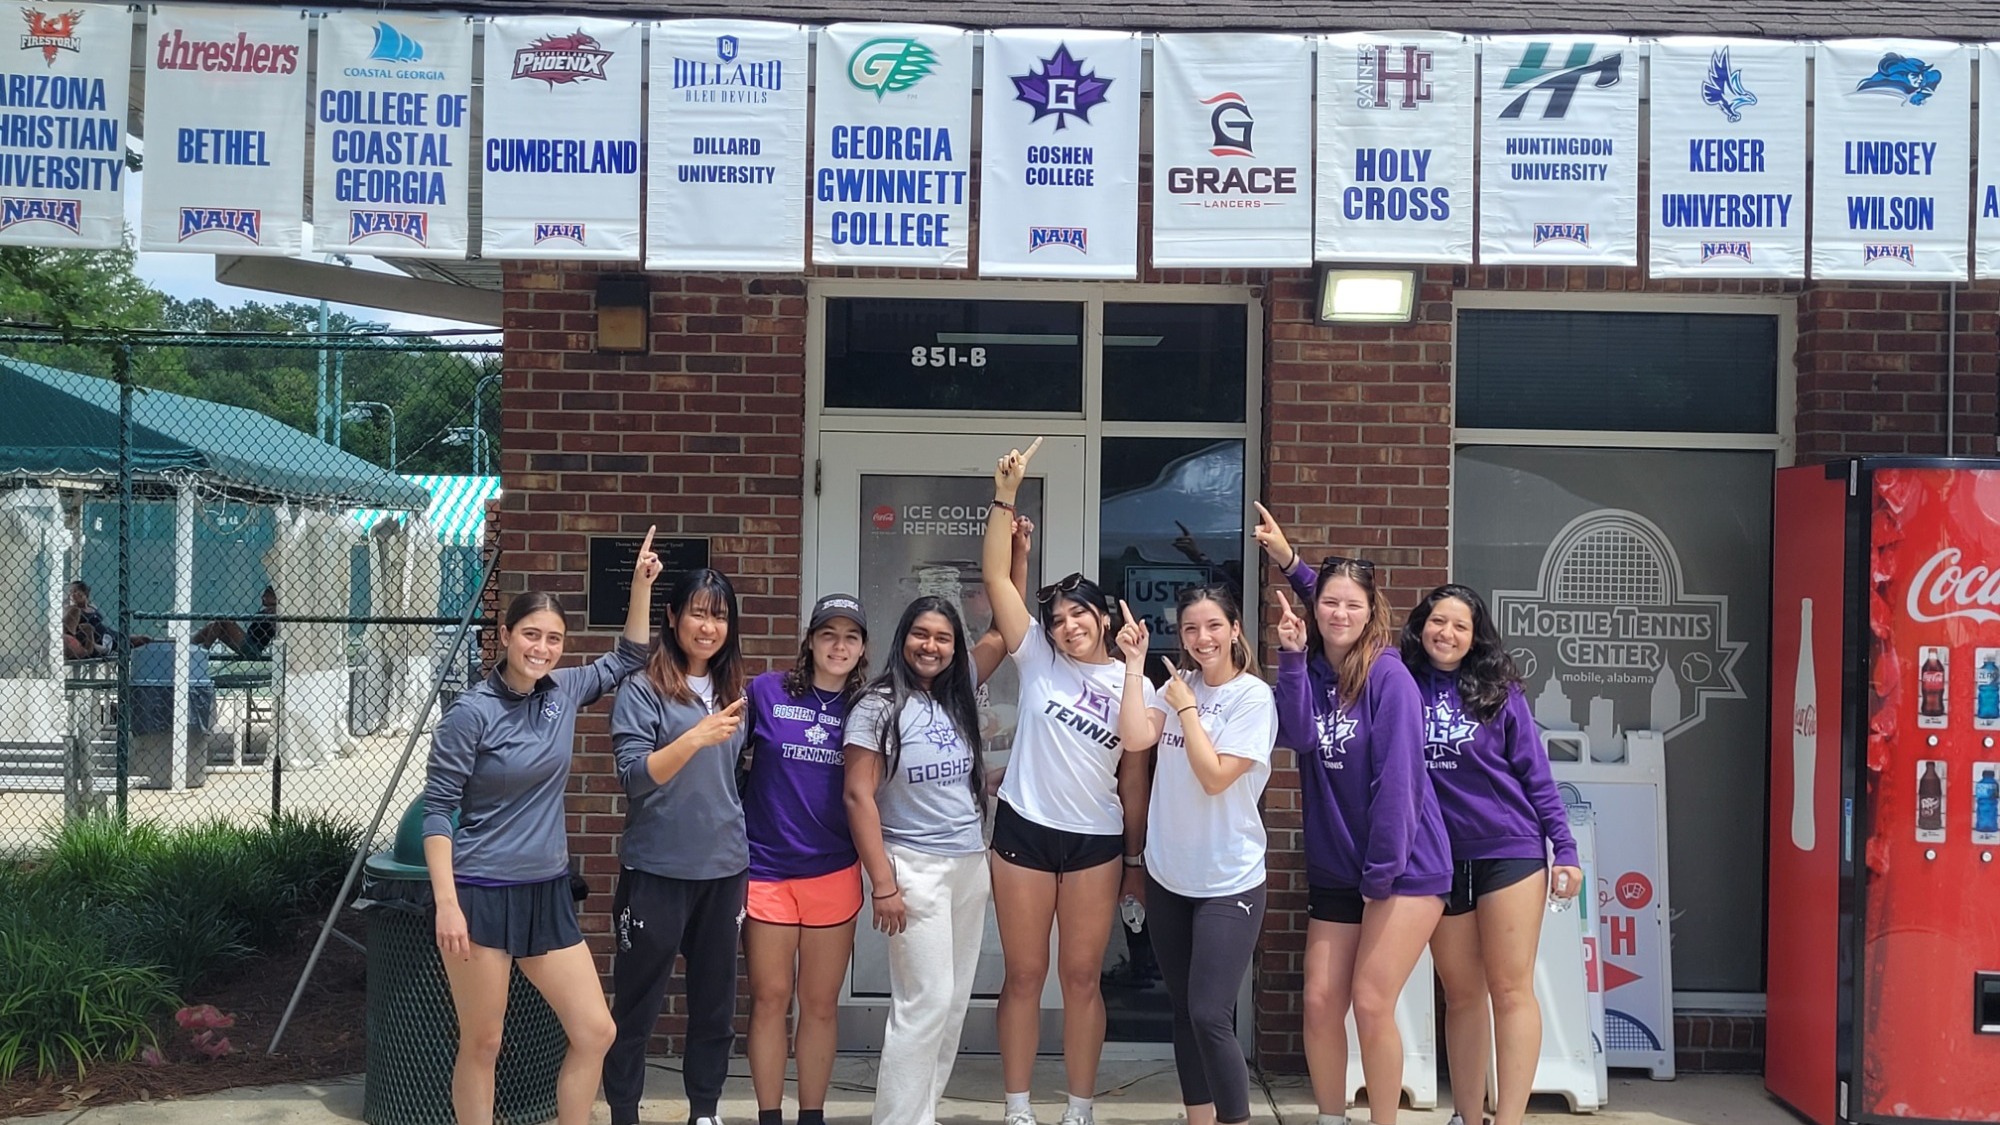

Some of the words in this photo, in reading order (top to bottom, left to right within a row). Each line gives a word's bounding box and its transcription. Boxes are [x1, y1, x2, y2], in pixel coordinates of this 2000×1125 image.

[20, 34, 81, 53] FIRESTORM
[157, 29, 299, 75] threshers
[343, 67, 393, 79] COASTAL
[396, 69, 446, 81] GEORGIA
[516, 52, 605, 75] PHOENIX
[672, 56, 782, 91] DILLARD
[320, 89, 427, 128] COLLEGE
[436, 92, 468, 128] OF
[721, 90, 767, 104] DEVILS
[0, 113, 118, 152] RISTIAN
[177, 127, 271, 167] BETHEL
[693, 137, 761, 156] DILLARD
[832, 125, 952, 161] GEORGIA
[1506, 138, 1613, 156] HUNTINGDON
[332, 130, 453, 167] COASTAL
[486, 138, 637, 174] CUMBERLAND
[1027, 145, 1093, 165] GOSHEN
[1689, 139, 1765, 173] KEISER
[1844, 141, 1937, 175] LINDSEY
[0, 153, 124, 192] IVERSITY
[678, 164, 776, 184] UNIVERSITY
[1025, 167, 1094, 187] COLLEGE
[1168, 166, 1297, 194] GRACE
[1355, 148, 1432, 182] HOLY
[1511, 163, 1607, 181] UNIVERSITY
[335, 168, 446, 205] GEORGIA
[817, 168, 967, 204] GWINNETT
[2, 198, 80, 230] NAIA
[1203, 199, 1262, 209] LANCERS
[1343, 186, 1450, 221] CROSS
[1662, 194, 1792, 228] UNIVERSITY
[1847, 196, 1934, 230] WILSON
[181, 207, 259, 243] NAIA
[350, 211, 427, 246] NAIA
[535, 223, 585, 245] NAIA
[831, 211, 950, 247] COLLEGE
[1030, 226, 1086, 252] NAIA
[1534, 224, 1588, 246] NAIA
[1702, 242, 1751, 263] NAIA
[1865, 245, 1914, 265] NAIA
[911, 346, 987, 367] 851-B
[903, 506, 932, 519] ICE
[938, 506, 988, 520] COLD
[903, 521, 987, 536] REFRESH
[1508, 603, 1612, 638] MOBILE
[1610, 606, 1711, 640] TENNIS
[1557, 637, 1661, 671] CENTER
[1562, 671, 1604, 684] mobile,
[1607, 671, 1654, 684] alabama
[772, 704, 816, 722] GOSHEN
[1044, 700, 1121, 750] TENNIS
[782, 743, 845, 765] TENNIS
[907, 758, 973, 784] GOSHE
